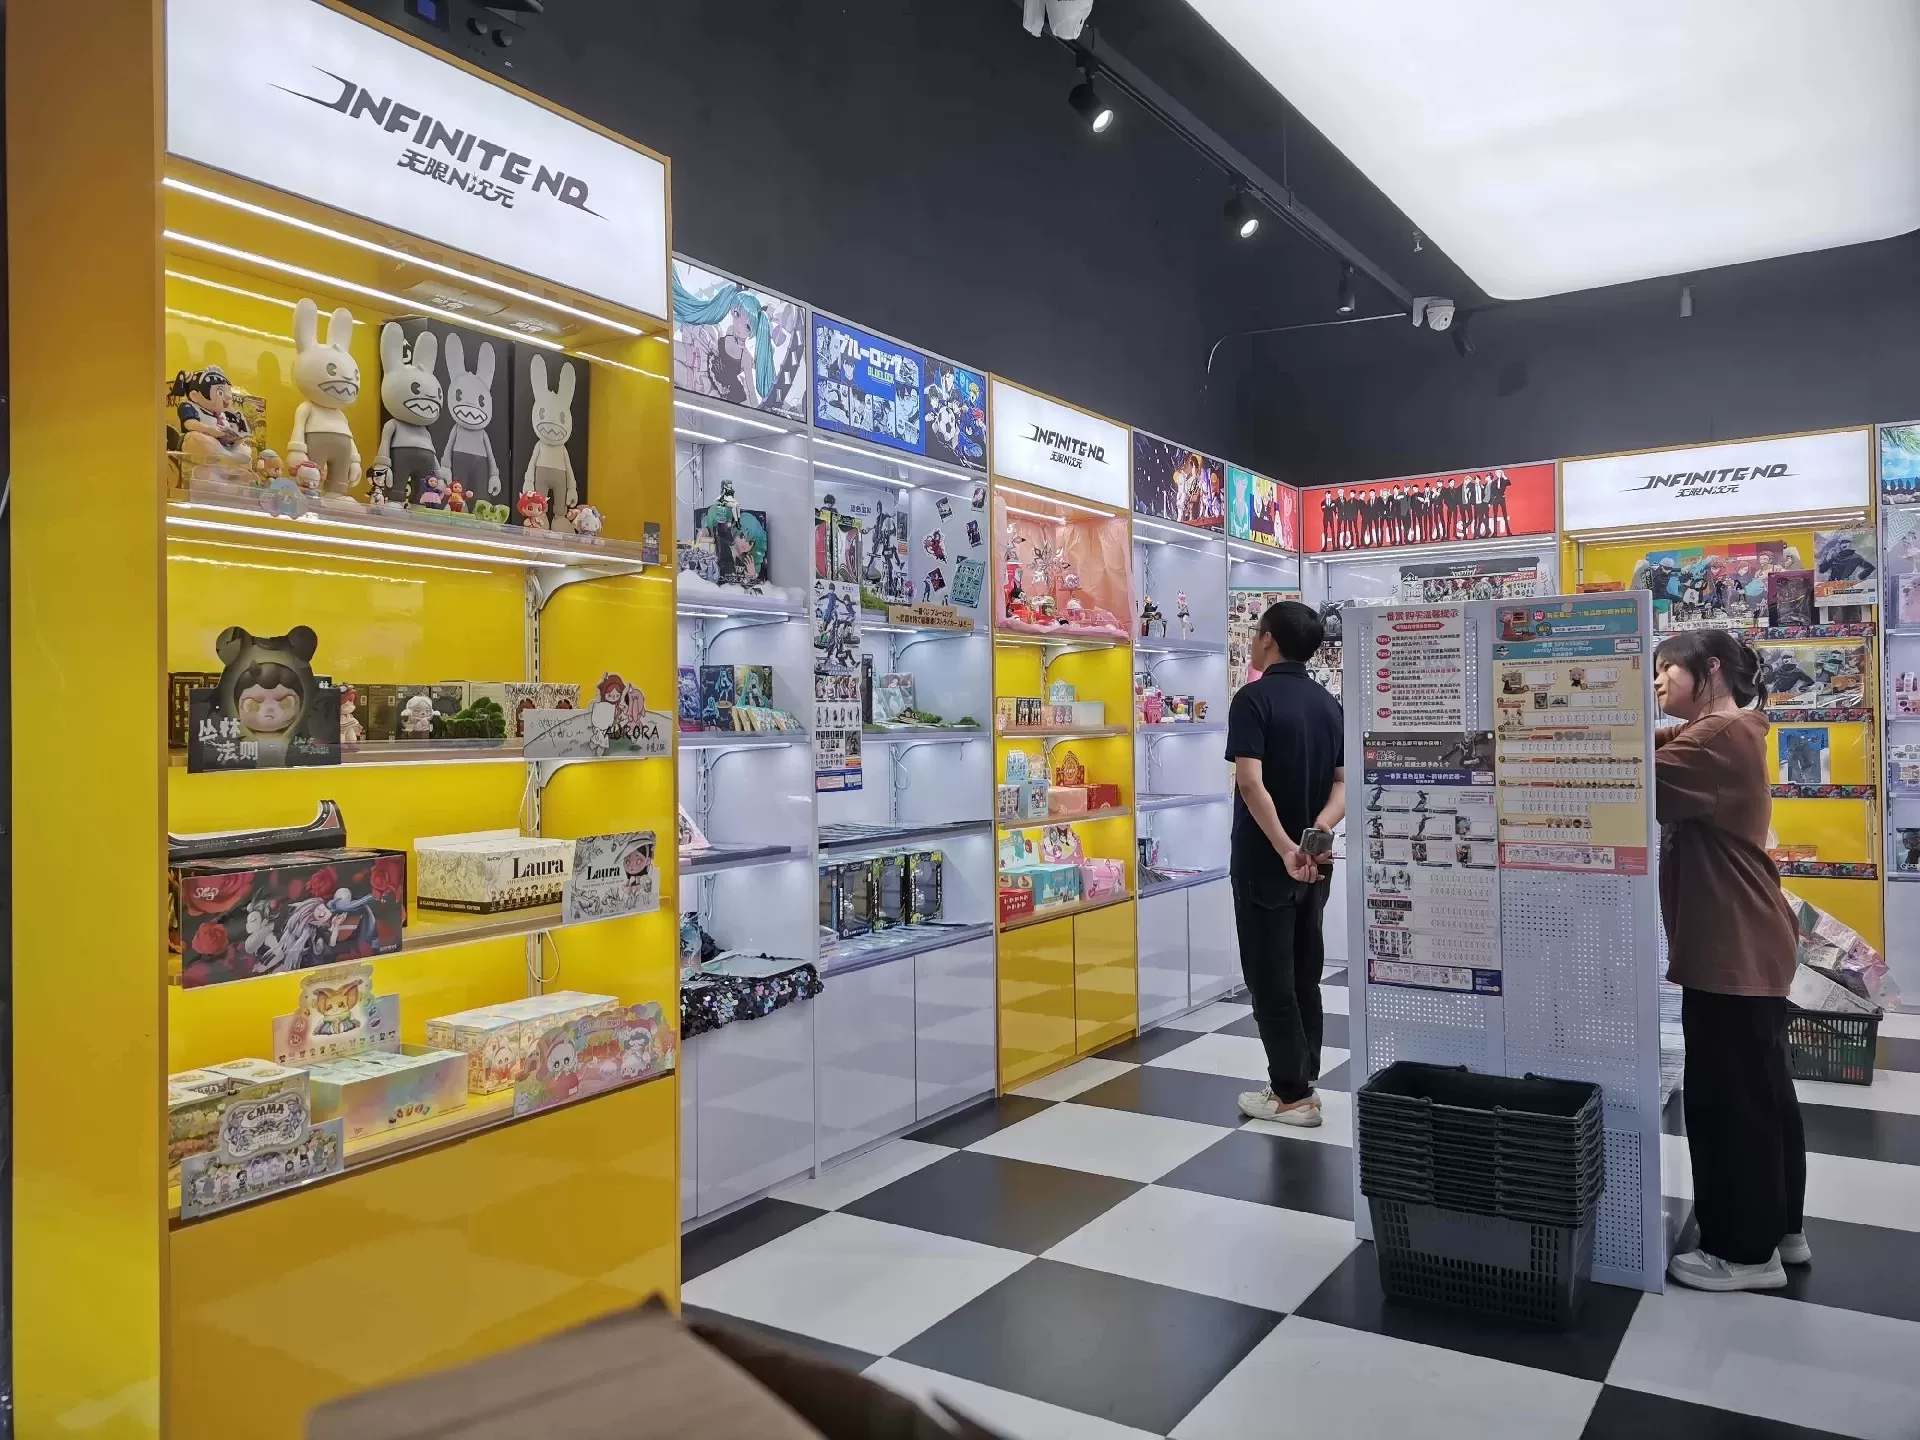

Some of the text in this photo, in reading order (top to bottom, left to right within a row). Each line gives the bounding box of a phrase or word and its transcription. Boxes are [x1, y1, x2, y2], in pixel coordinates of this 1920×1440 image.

[267, 65, 532, 181] INFINITE
[397, 148, 515, 209] 无限N次元
[1016, 422, 1088, 458] INFINITE
[1619, 466, 1751, 492] INFINITE
[1675, 484, 1740, 498] 无限N次元
[603, 724, 660, 741] AURORA
[216, 741, 259, 761] 法则
[512, 857, 564, 880] Laura
[586, 865, 620, 880] Laura
[247, 1103, 285, 1121] EMMA
